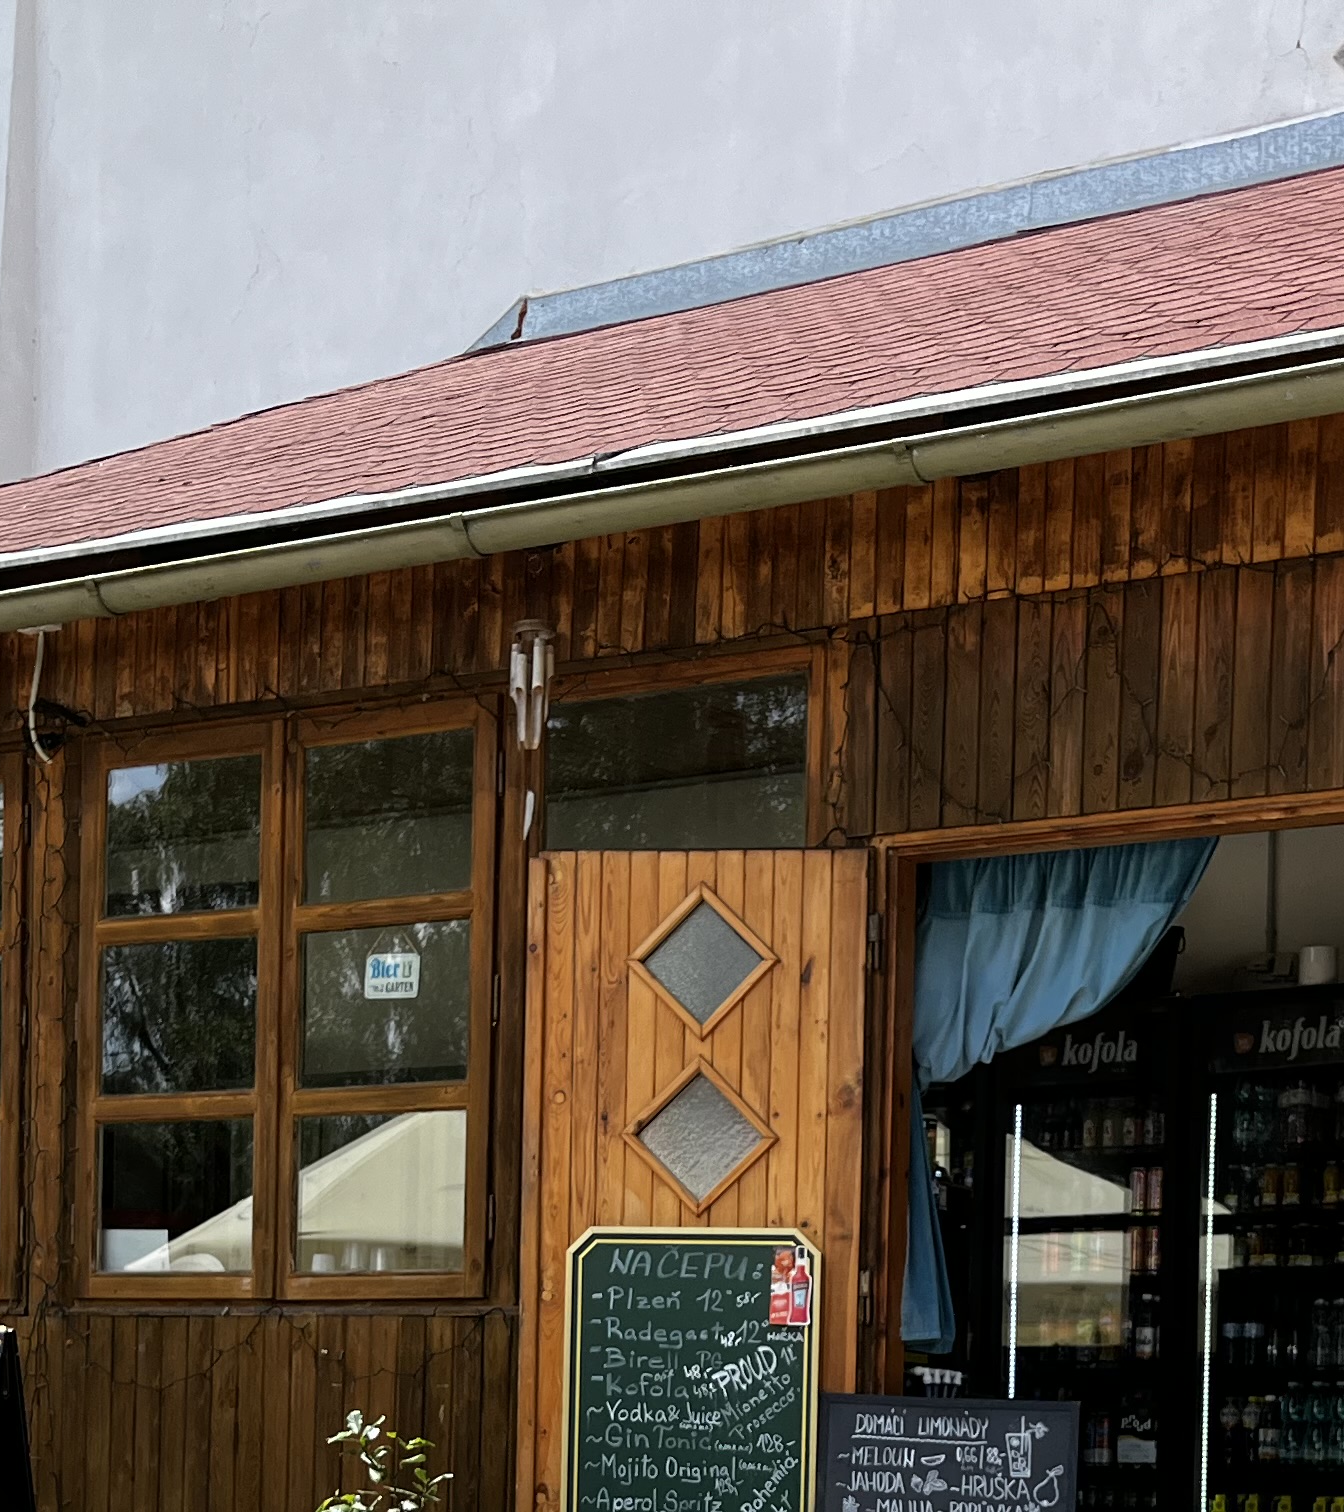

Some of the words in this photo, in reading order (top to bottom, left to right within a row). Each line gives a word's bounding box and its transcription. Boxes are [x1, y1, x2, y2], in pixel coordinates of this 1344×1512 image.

[1061, 1031, 1138, 1073] kofola
[1258, 1016, 1341, 1061] kofola
[609, 1249, 651, 1277] NA
[607, 1286, 681, 1311] Plzeň
[712, 1345, 778, 1398] PROUD
[606, 1423, 650, 1449] Gin
[856, 1408, 905, 1434] DOMÁCÍ
[918, 1411, 989, 1440] LIMONÁDY
[601, 1454, 658, 1485] Mojito
